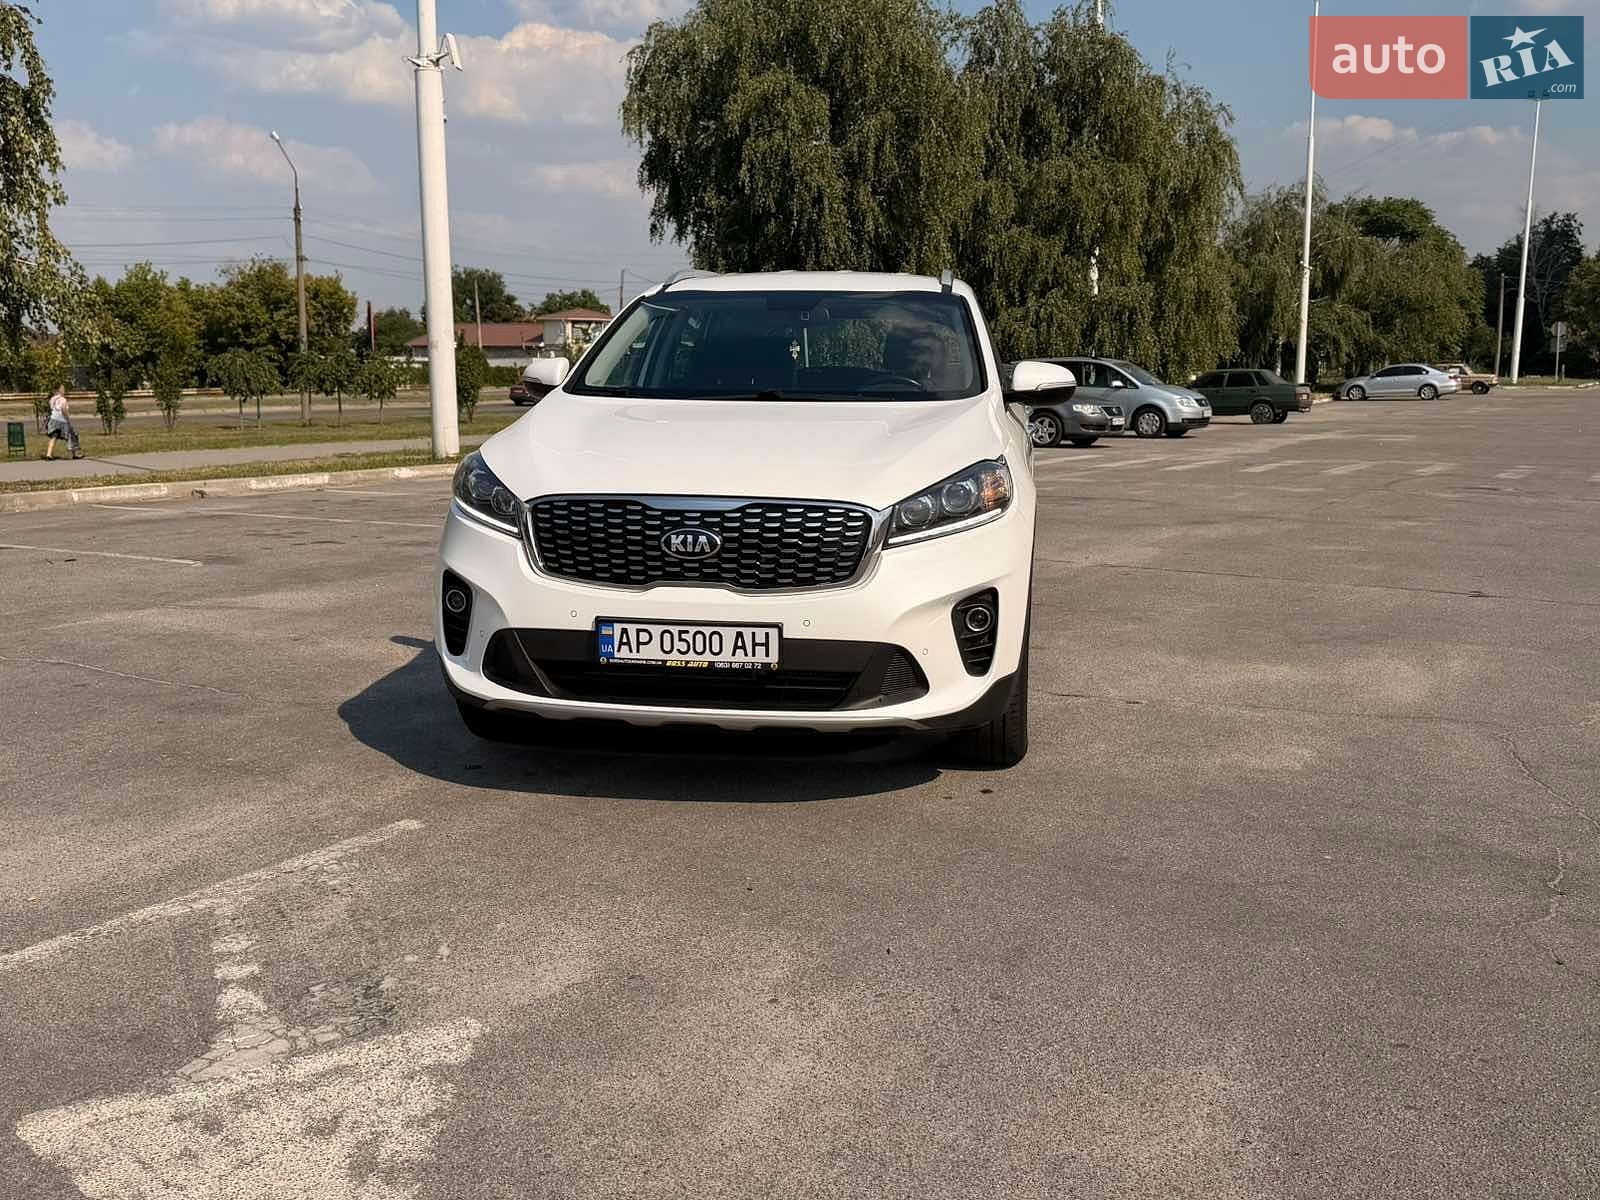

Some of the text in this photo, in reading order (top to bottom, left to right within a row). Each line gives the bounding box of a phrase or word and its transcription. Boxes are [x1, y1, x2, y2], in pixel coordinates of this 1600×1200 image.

[670, 534, 711, 553] KIA
[601, 644, 614, 653] UA
[616, 627, 770, 658] AP 0500 AH
